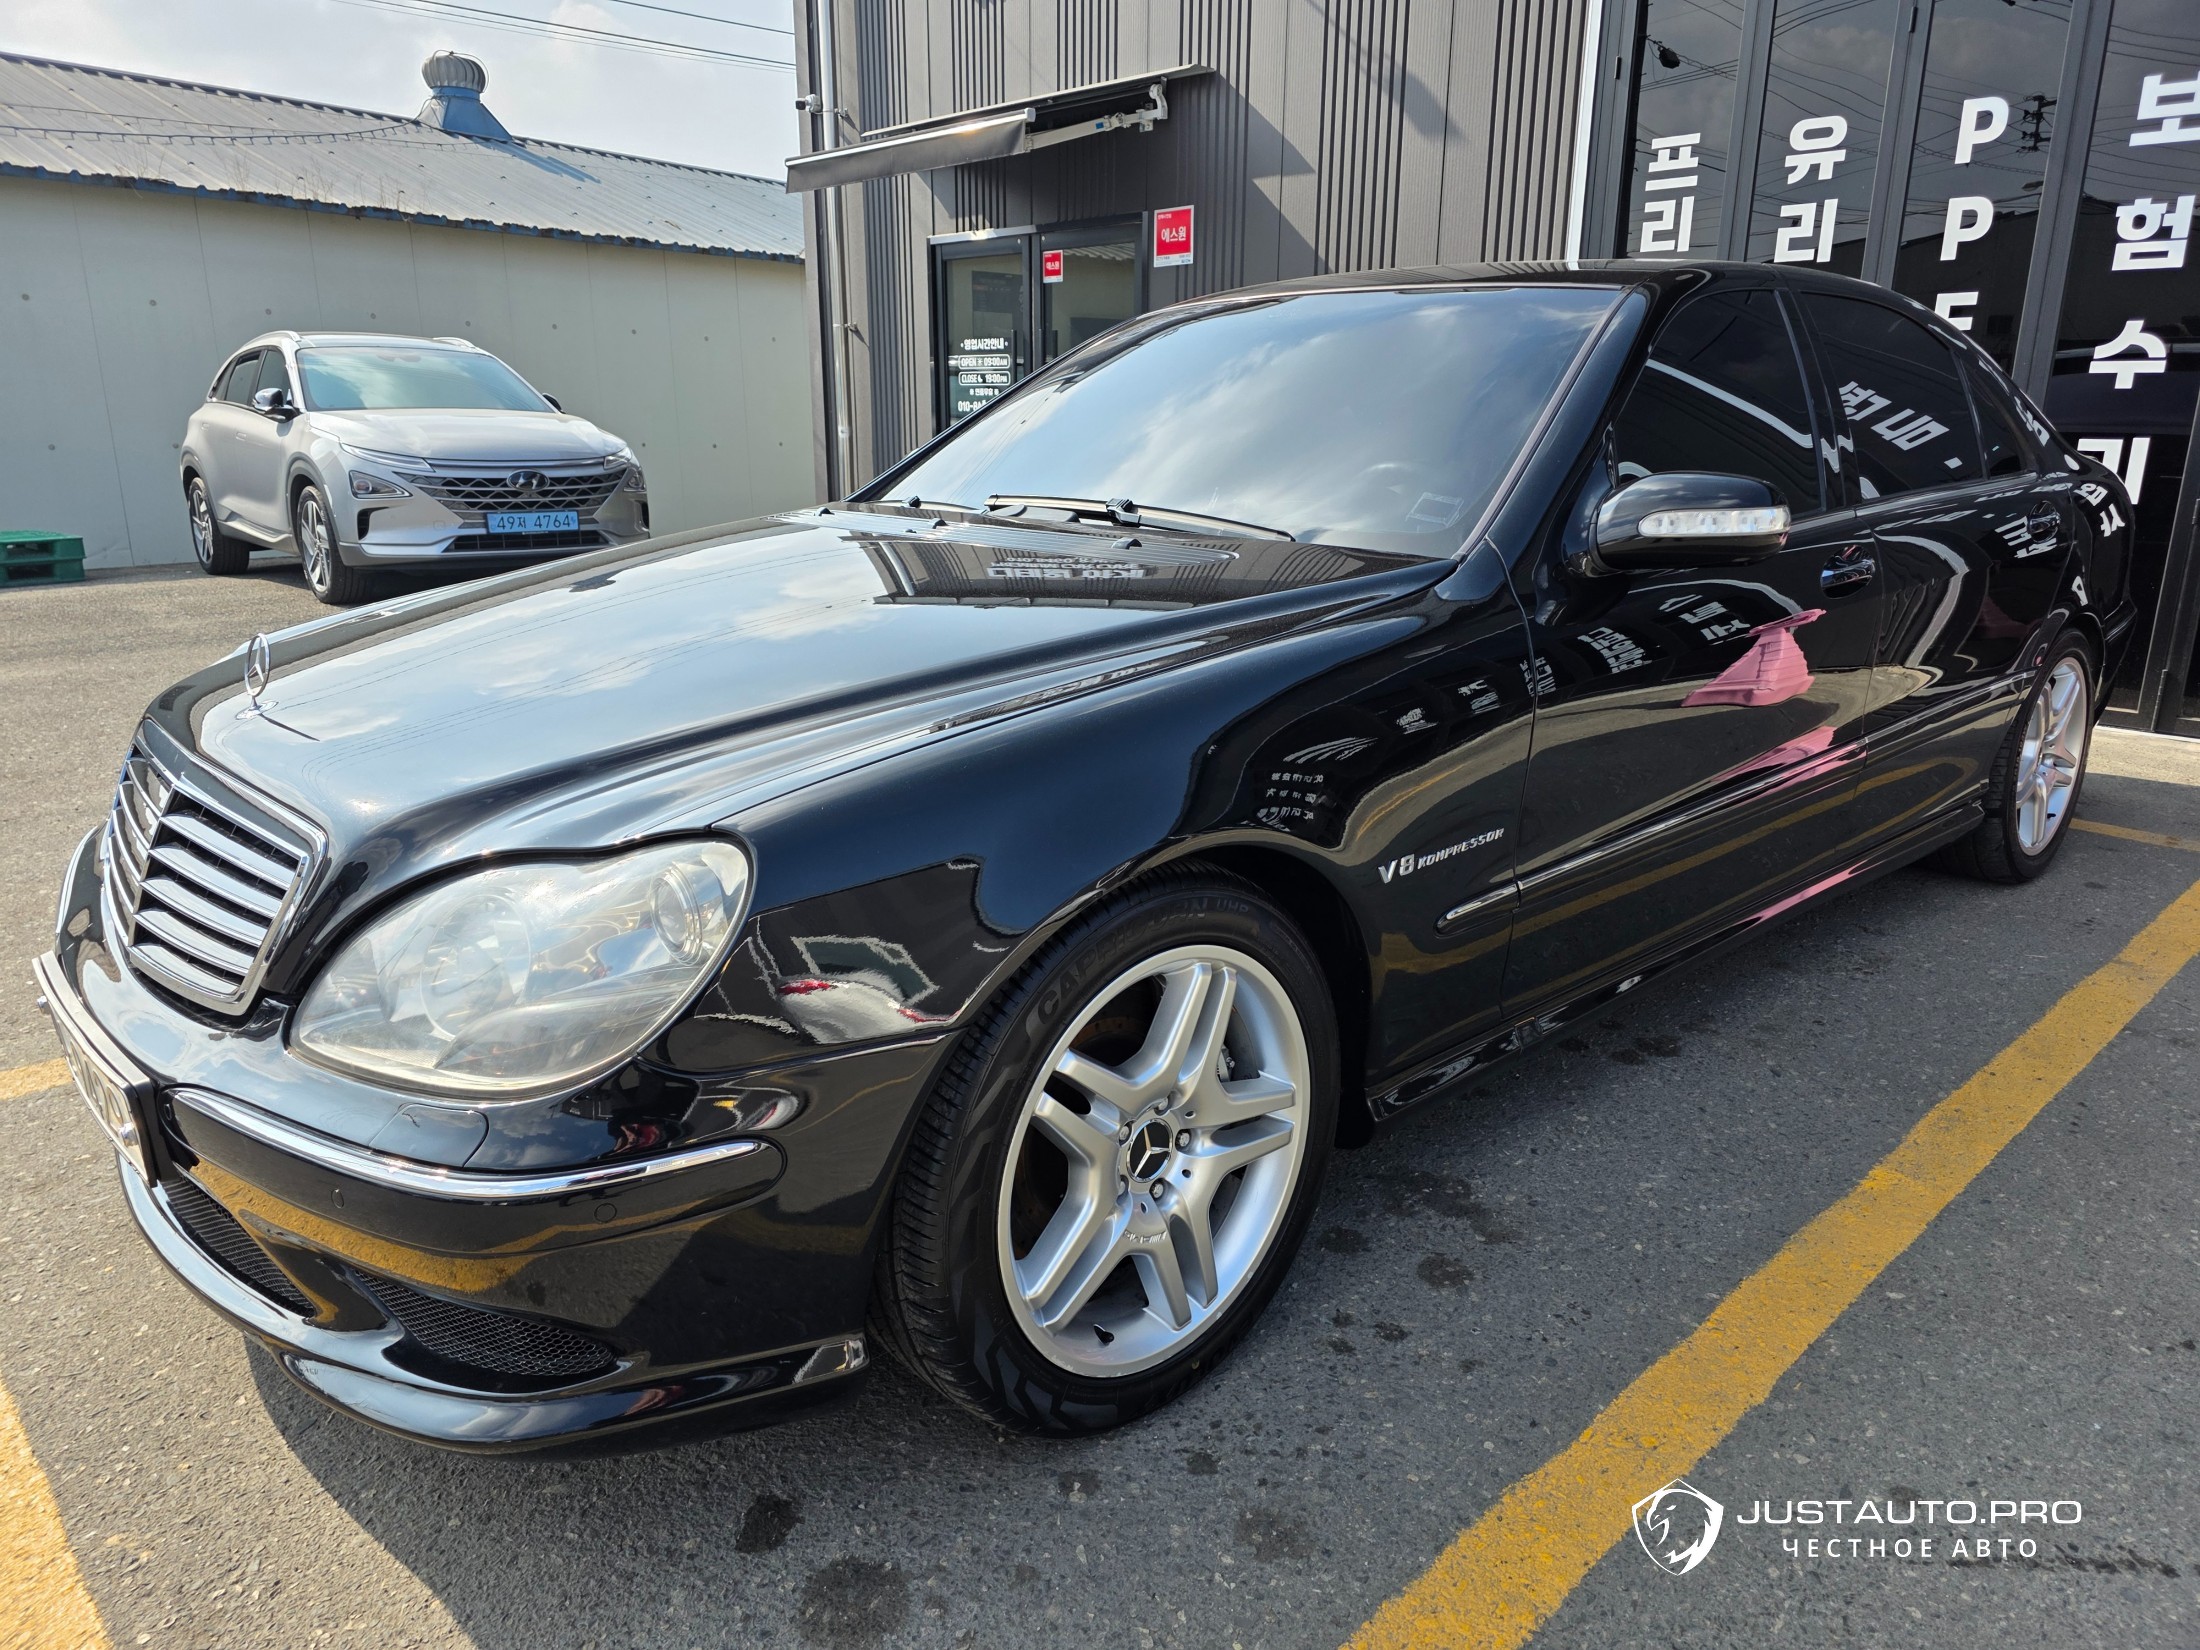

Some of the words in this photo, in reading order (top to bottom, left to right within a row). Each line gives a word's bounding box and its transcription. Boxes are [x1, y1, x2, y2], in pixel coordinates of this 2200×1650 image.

[1640, 132, 1701, 253] 프리
[1774, 115, 1848, 263] 유리
[1161, 226, 1186, 243] 에스원
[963, 337, 1004, 350] 영업시간안내
[961, 357, 977, 366] OPEN
[961, 374, 978, 383] CLOSE
[533, 514, 571, 529] 4764
[1378, 853, 1415, 885] V8
[1416, 827, 1505, 870] KOMPRESSOR
[1216, 898, 1249, 914] UHP
